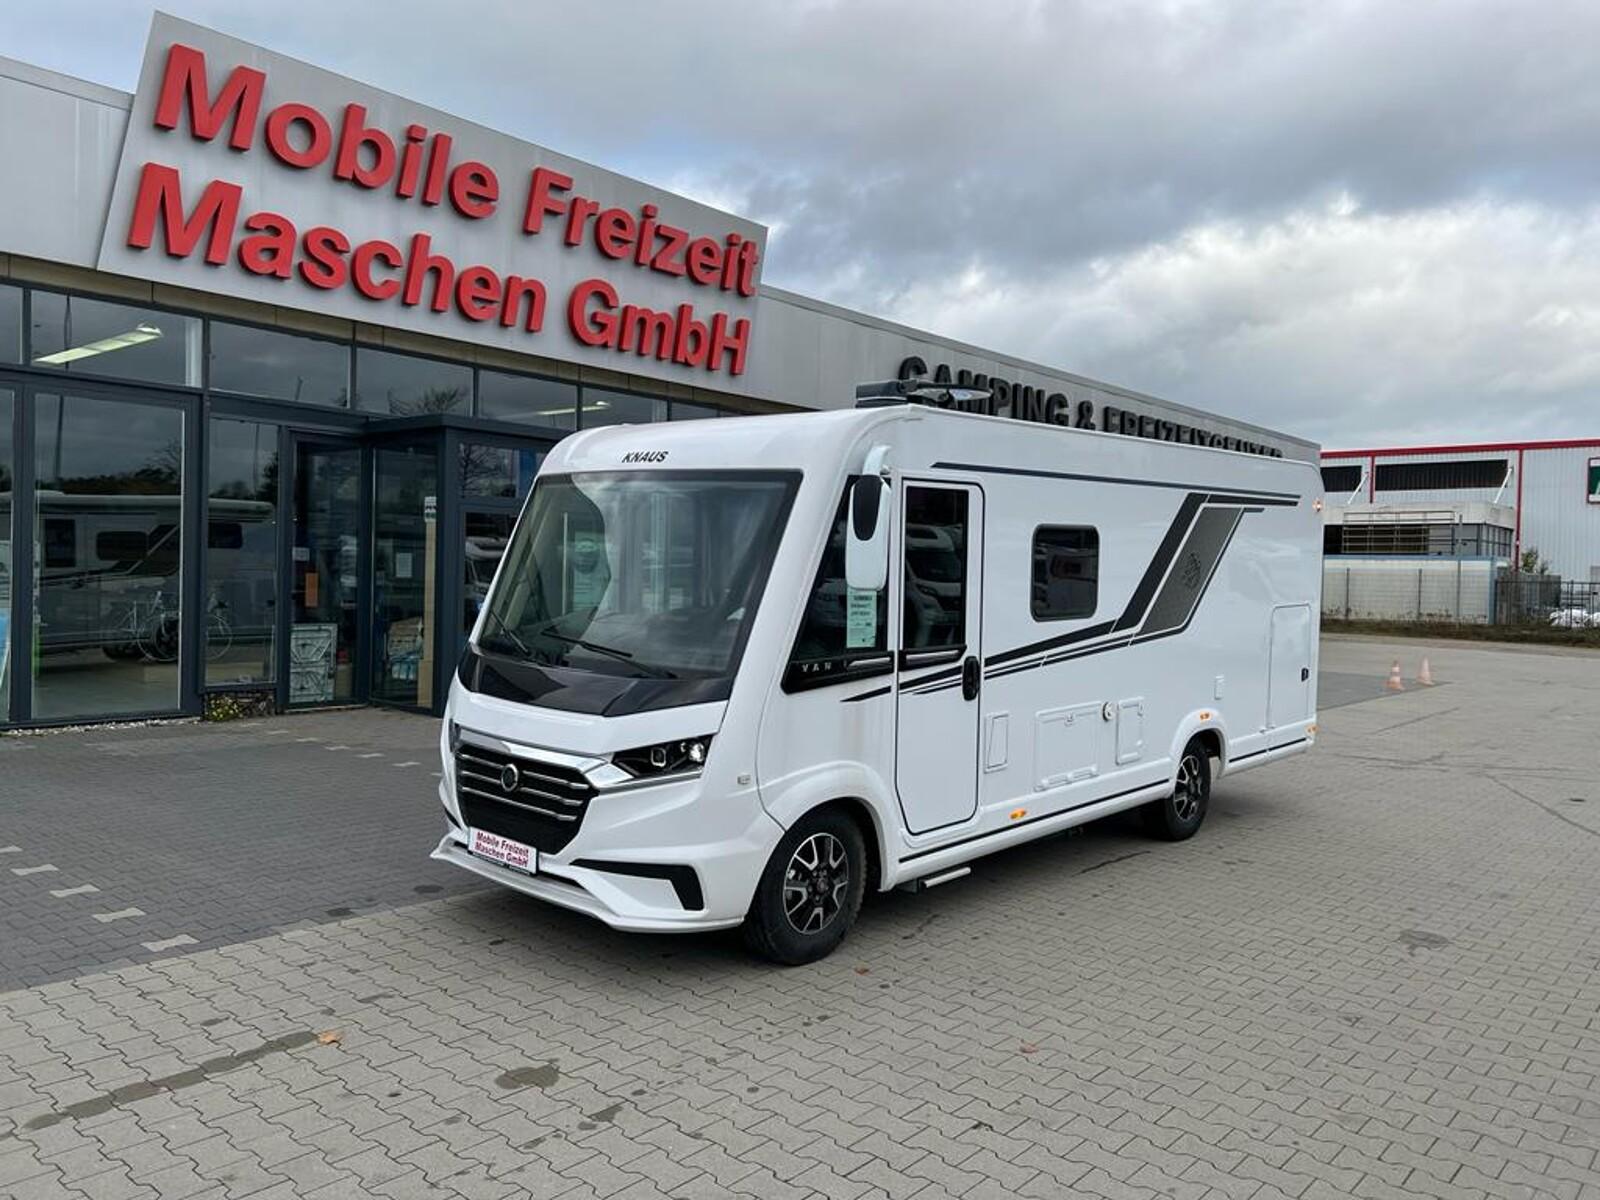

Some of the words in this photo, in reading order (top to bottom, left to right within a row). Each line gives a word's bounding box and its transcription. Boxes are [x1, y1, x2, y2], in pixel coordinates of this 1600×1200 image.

[155, 44, 500, 219] Mobile
[523, 167, 758, 295] Freizeit
[128, 163, 547, 332] Maschen
[567, 278, 751, 374] GmbH
[1075, 400, 1096, 430] &
[621, 451, 669, 463] KNAUS
[474, 841, 505, 860] Maschen
[506, 852, 529, 868] GmbH
[476, 831, 500, 847] Mobile
[501, 840, 529, 858] Freizeit
